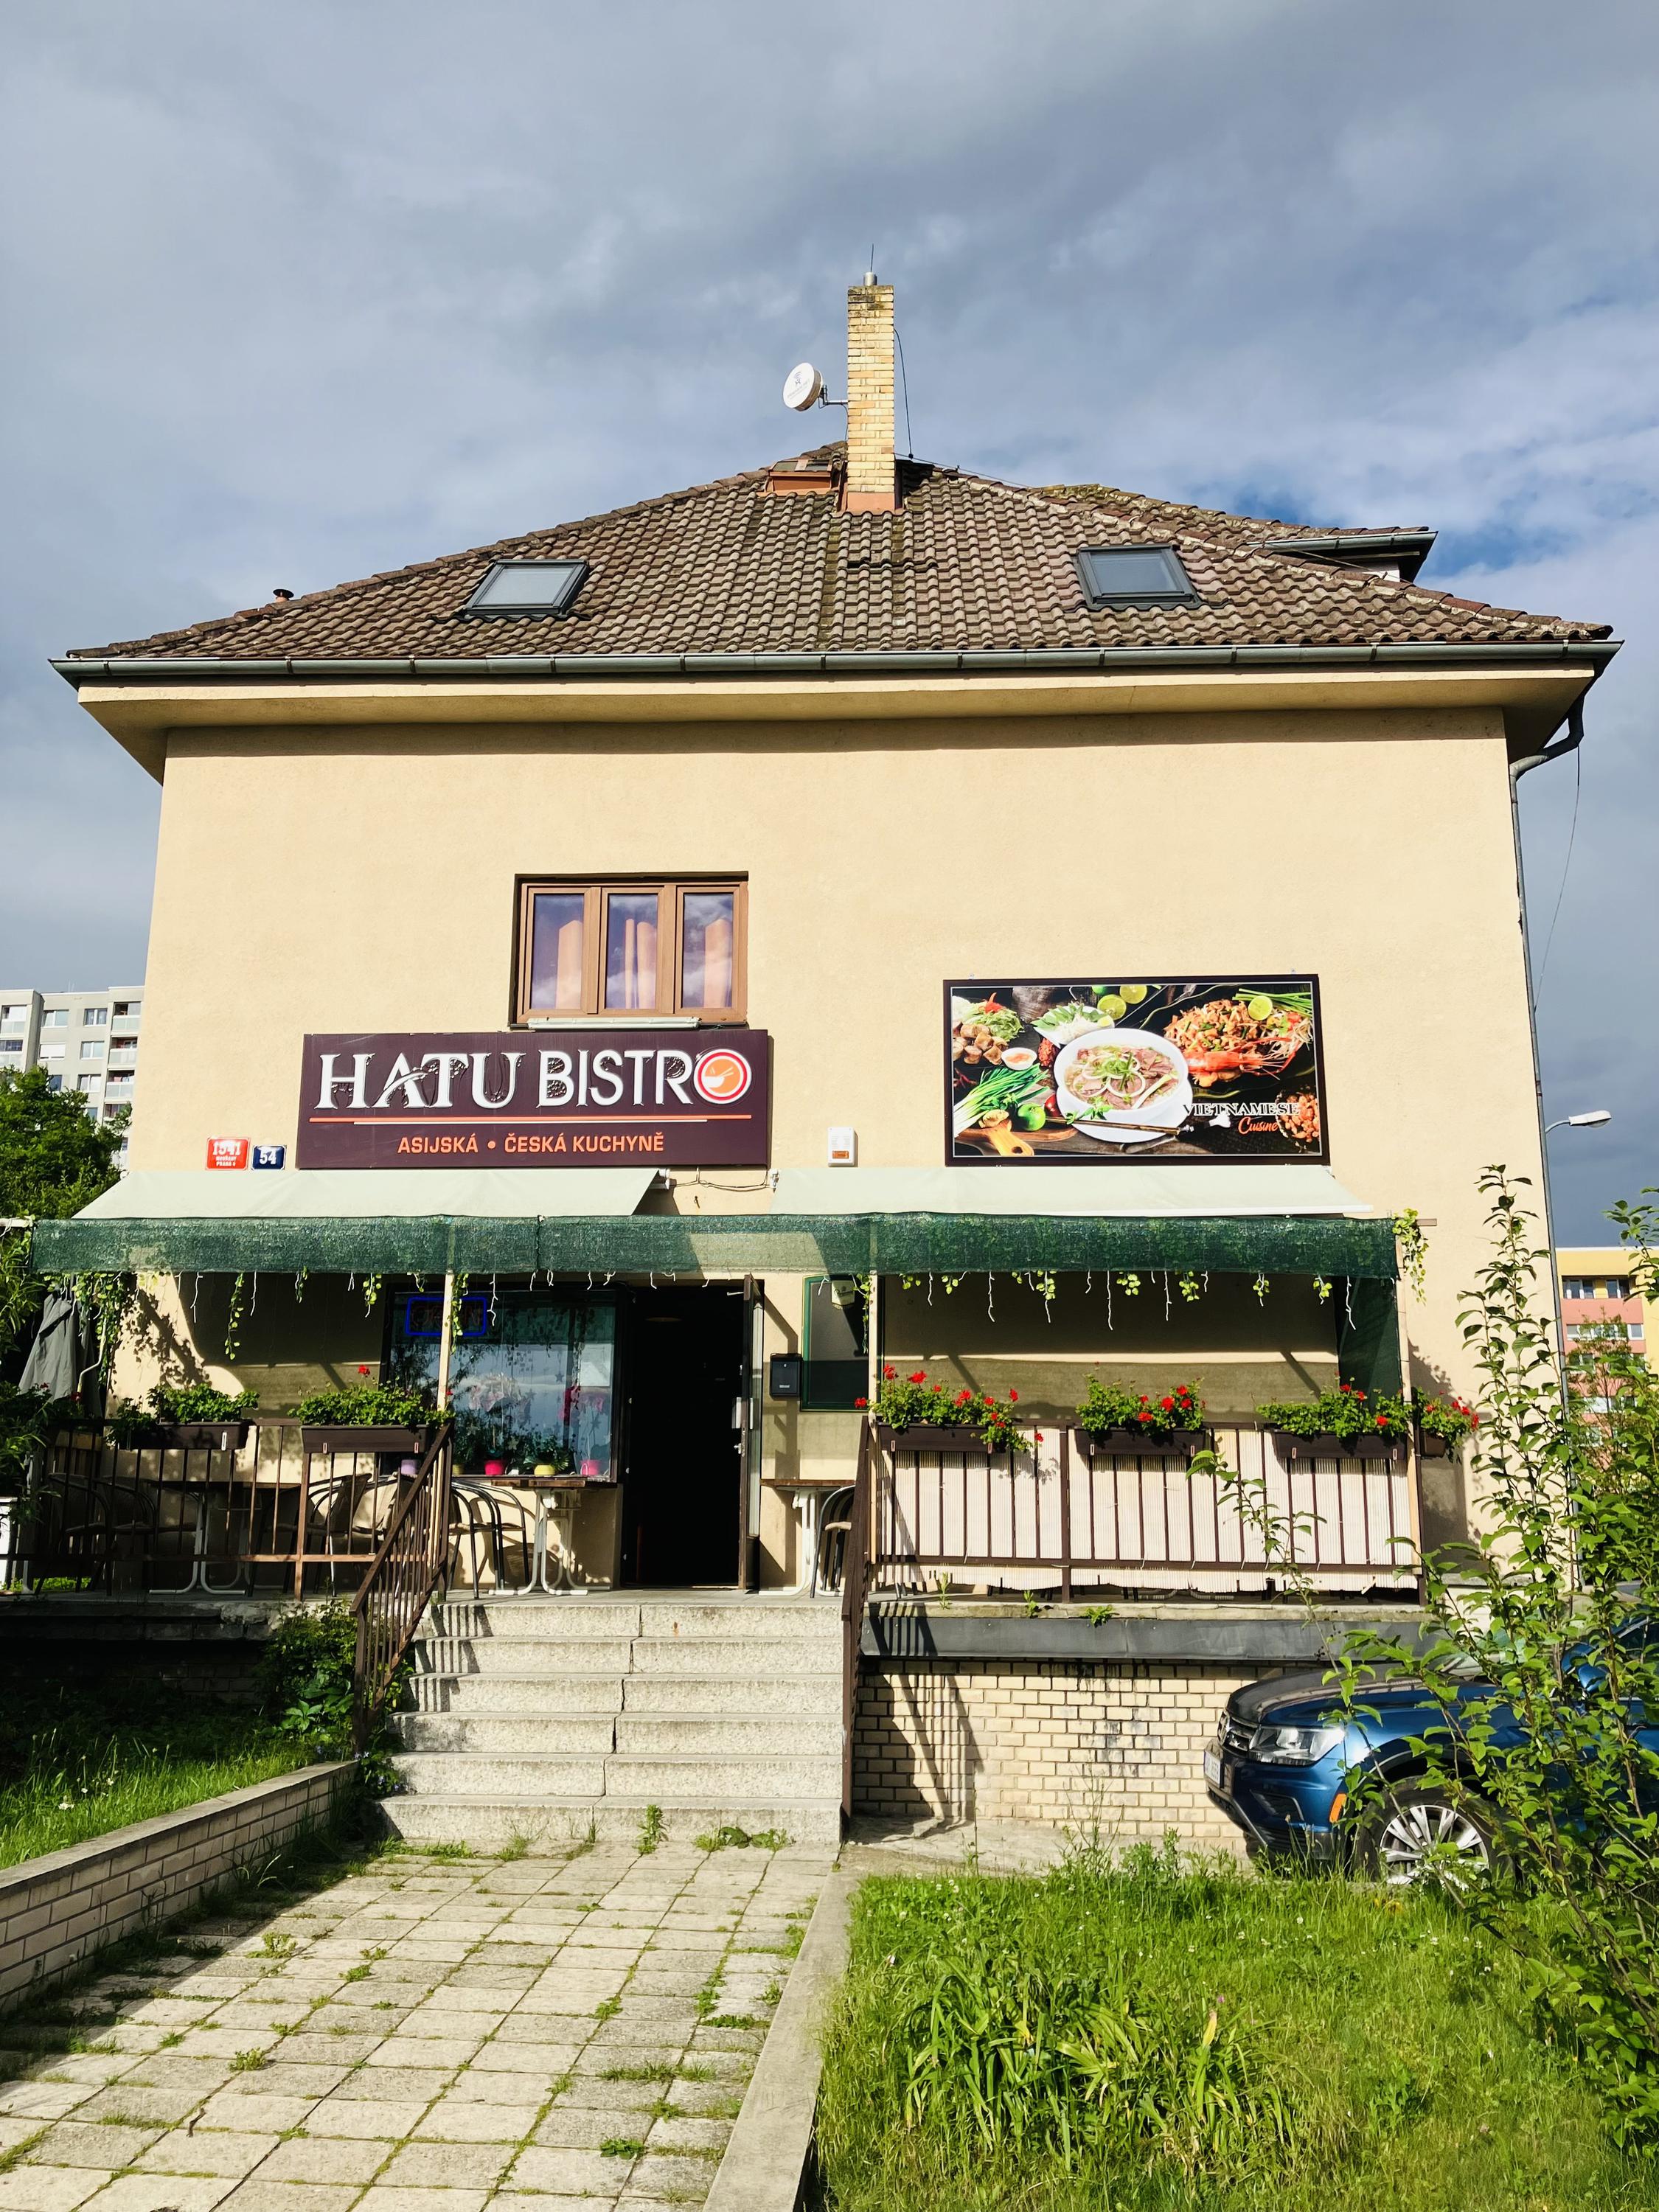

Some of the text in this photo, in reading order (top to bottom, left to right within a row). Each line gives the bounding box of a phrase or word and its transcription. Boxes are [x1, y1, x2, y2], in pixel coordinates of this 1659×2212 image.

[314, 1048, 752, 1109] HATU BISTRO
[1183, 1102, 1301, 1117] VIETNAMESE
[1238, 1117, 1279, 1135] Cuisine
[397, 1132, 664, 1153] ASIJSKÁ ČESKÁ KUCHYNĚ
[259, 1148, 277, 1165] 54
